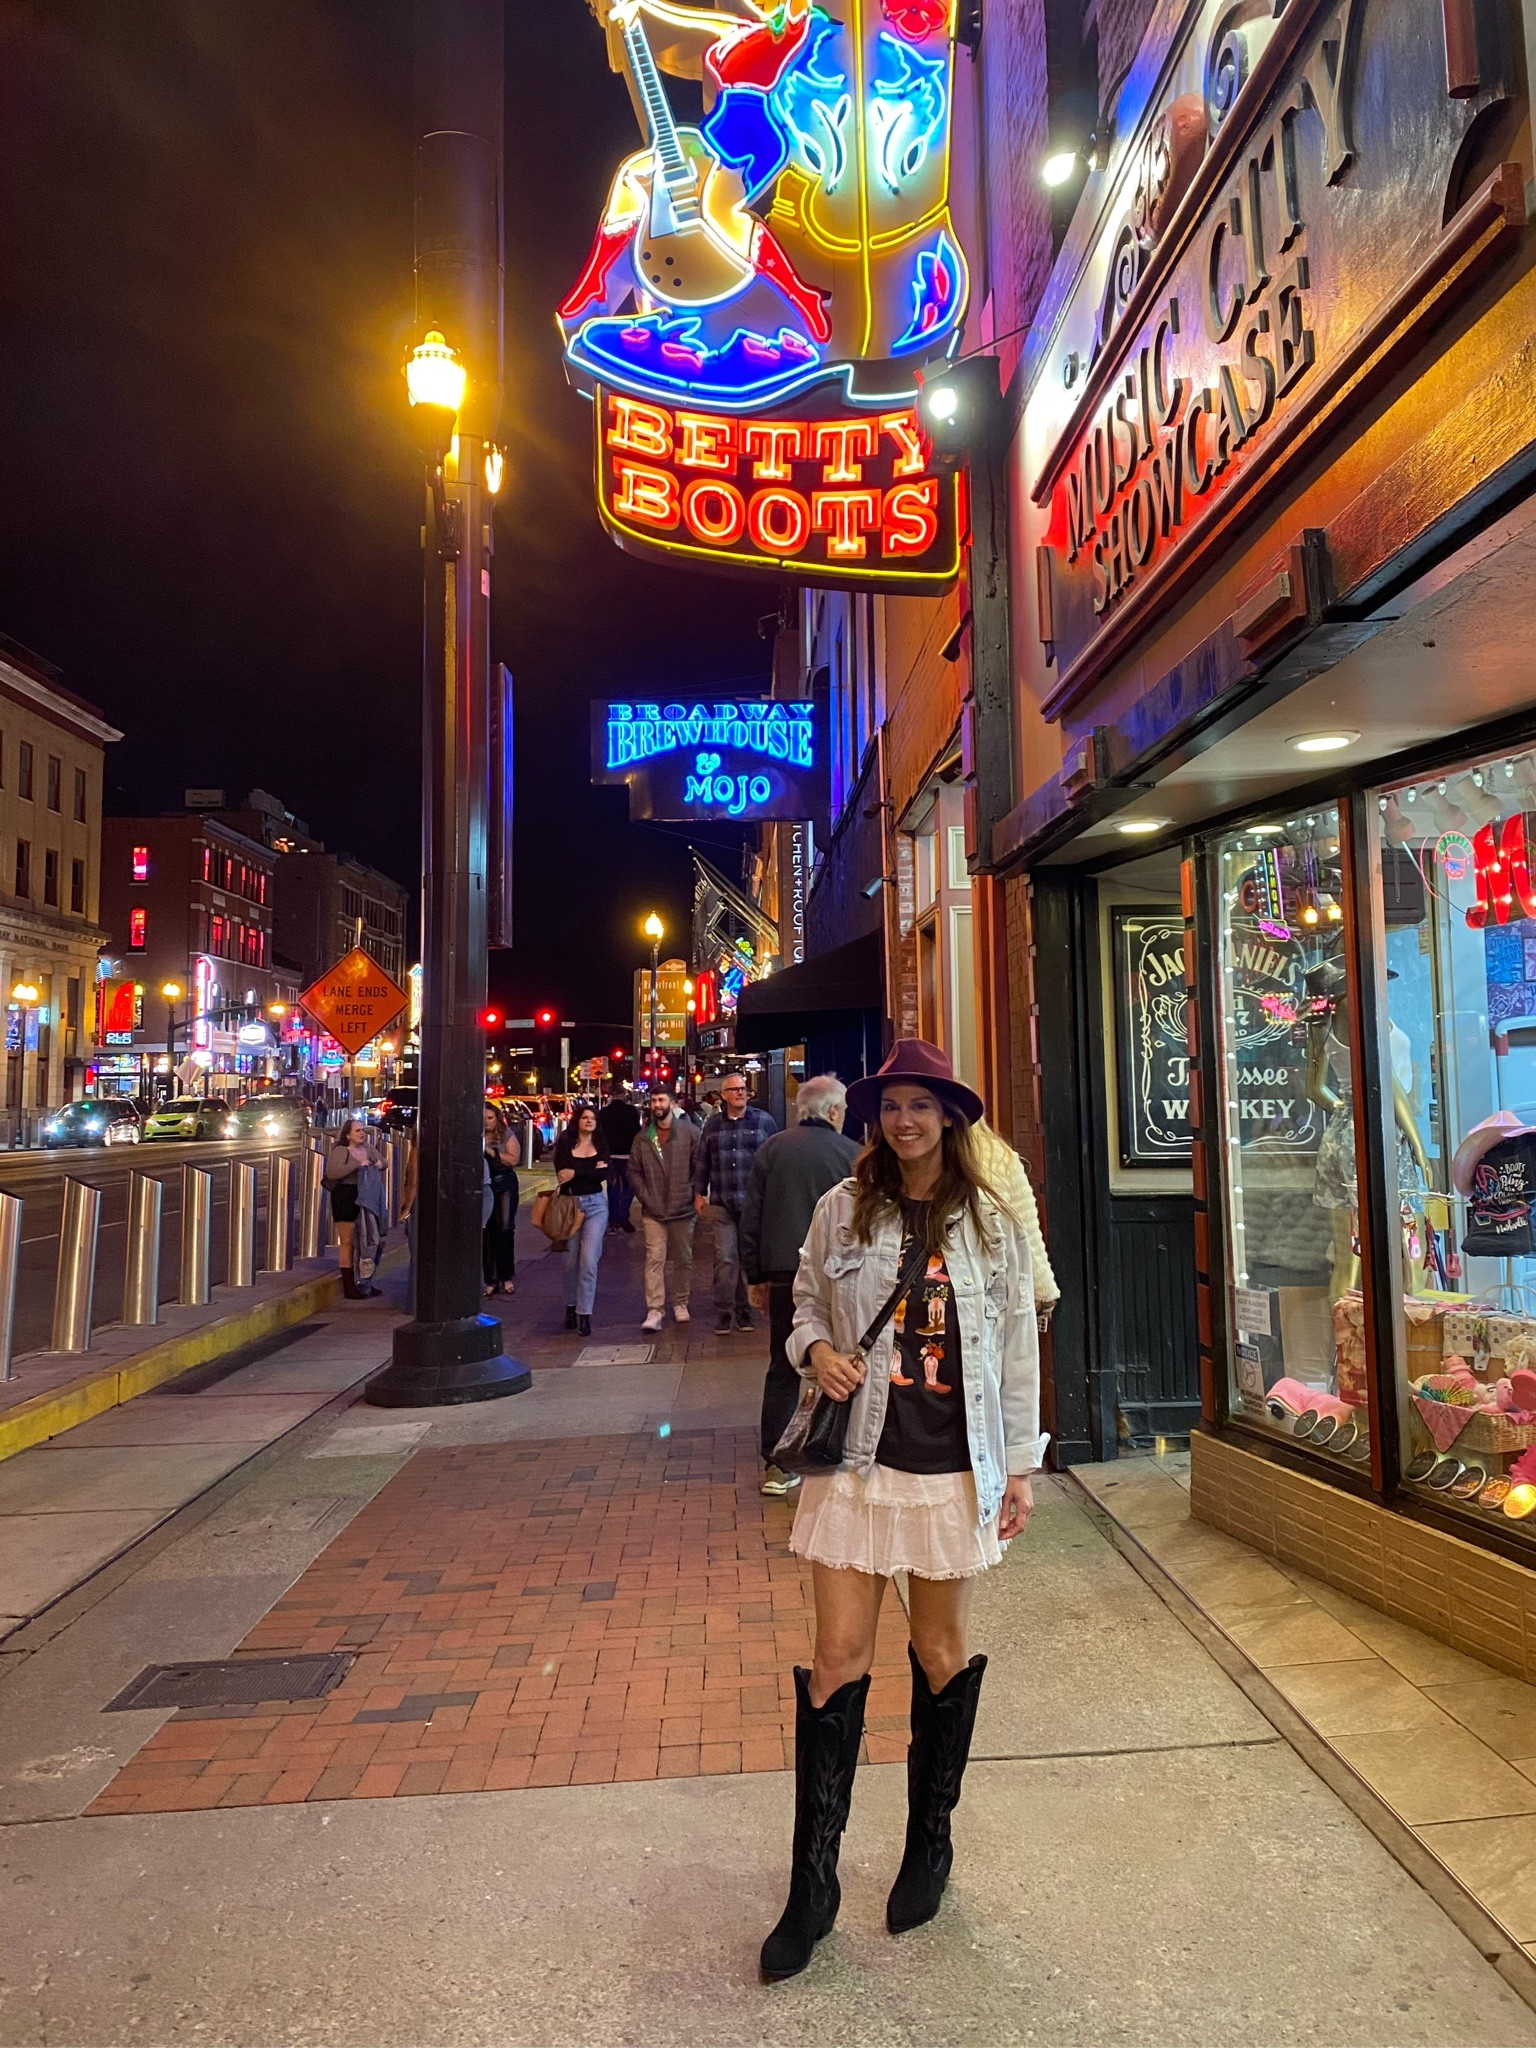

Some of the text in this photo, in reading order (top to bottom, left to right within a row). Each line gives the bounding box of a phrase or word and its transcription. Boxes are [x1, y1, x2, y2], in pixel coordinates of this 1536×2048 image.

[1066, 0, 1366, 563] MUSIC CITY
[607, 395, 928, 482] BETTY
[1093, 256, 1315, 616] SHOWCASE
[613, 456, 938, 558] BOOTS
[608, 704, 814, 720] BROADWAY
[607, 720, 812, 767] BREWHOUSE
[696, 753, 721, 774] &
[684, 775, 771, 814] MOJO
[323, 986, 388, 998] LANE ENDS
[336, 1004, 374, 1016] MERGE
[670, 1020, 684, 1028] Hill
[341, 1022, 367, 1034] LEFT
